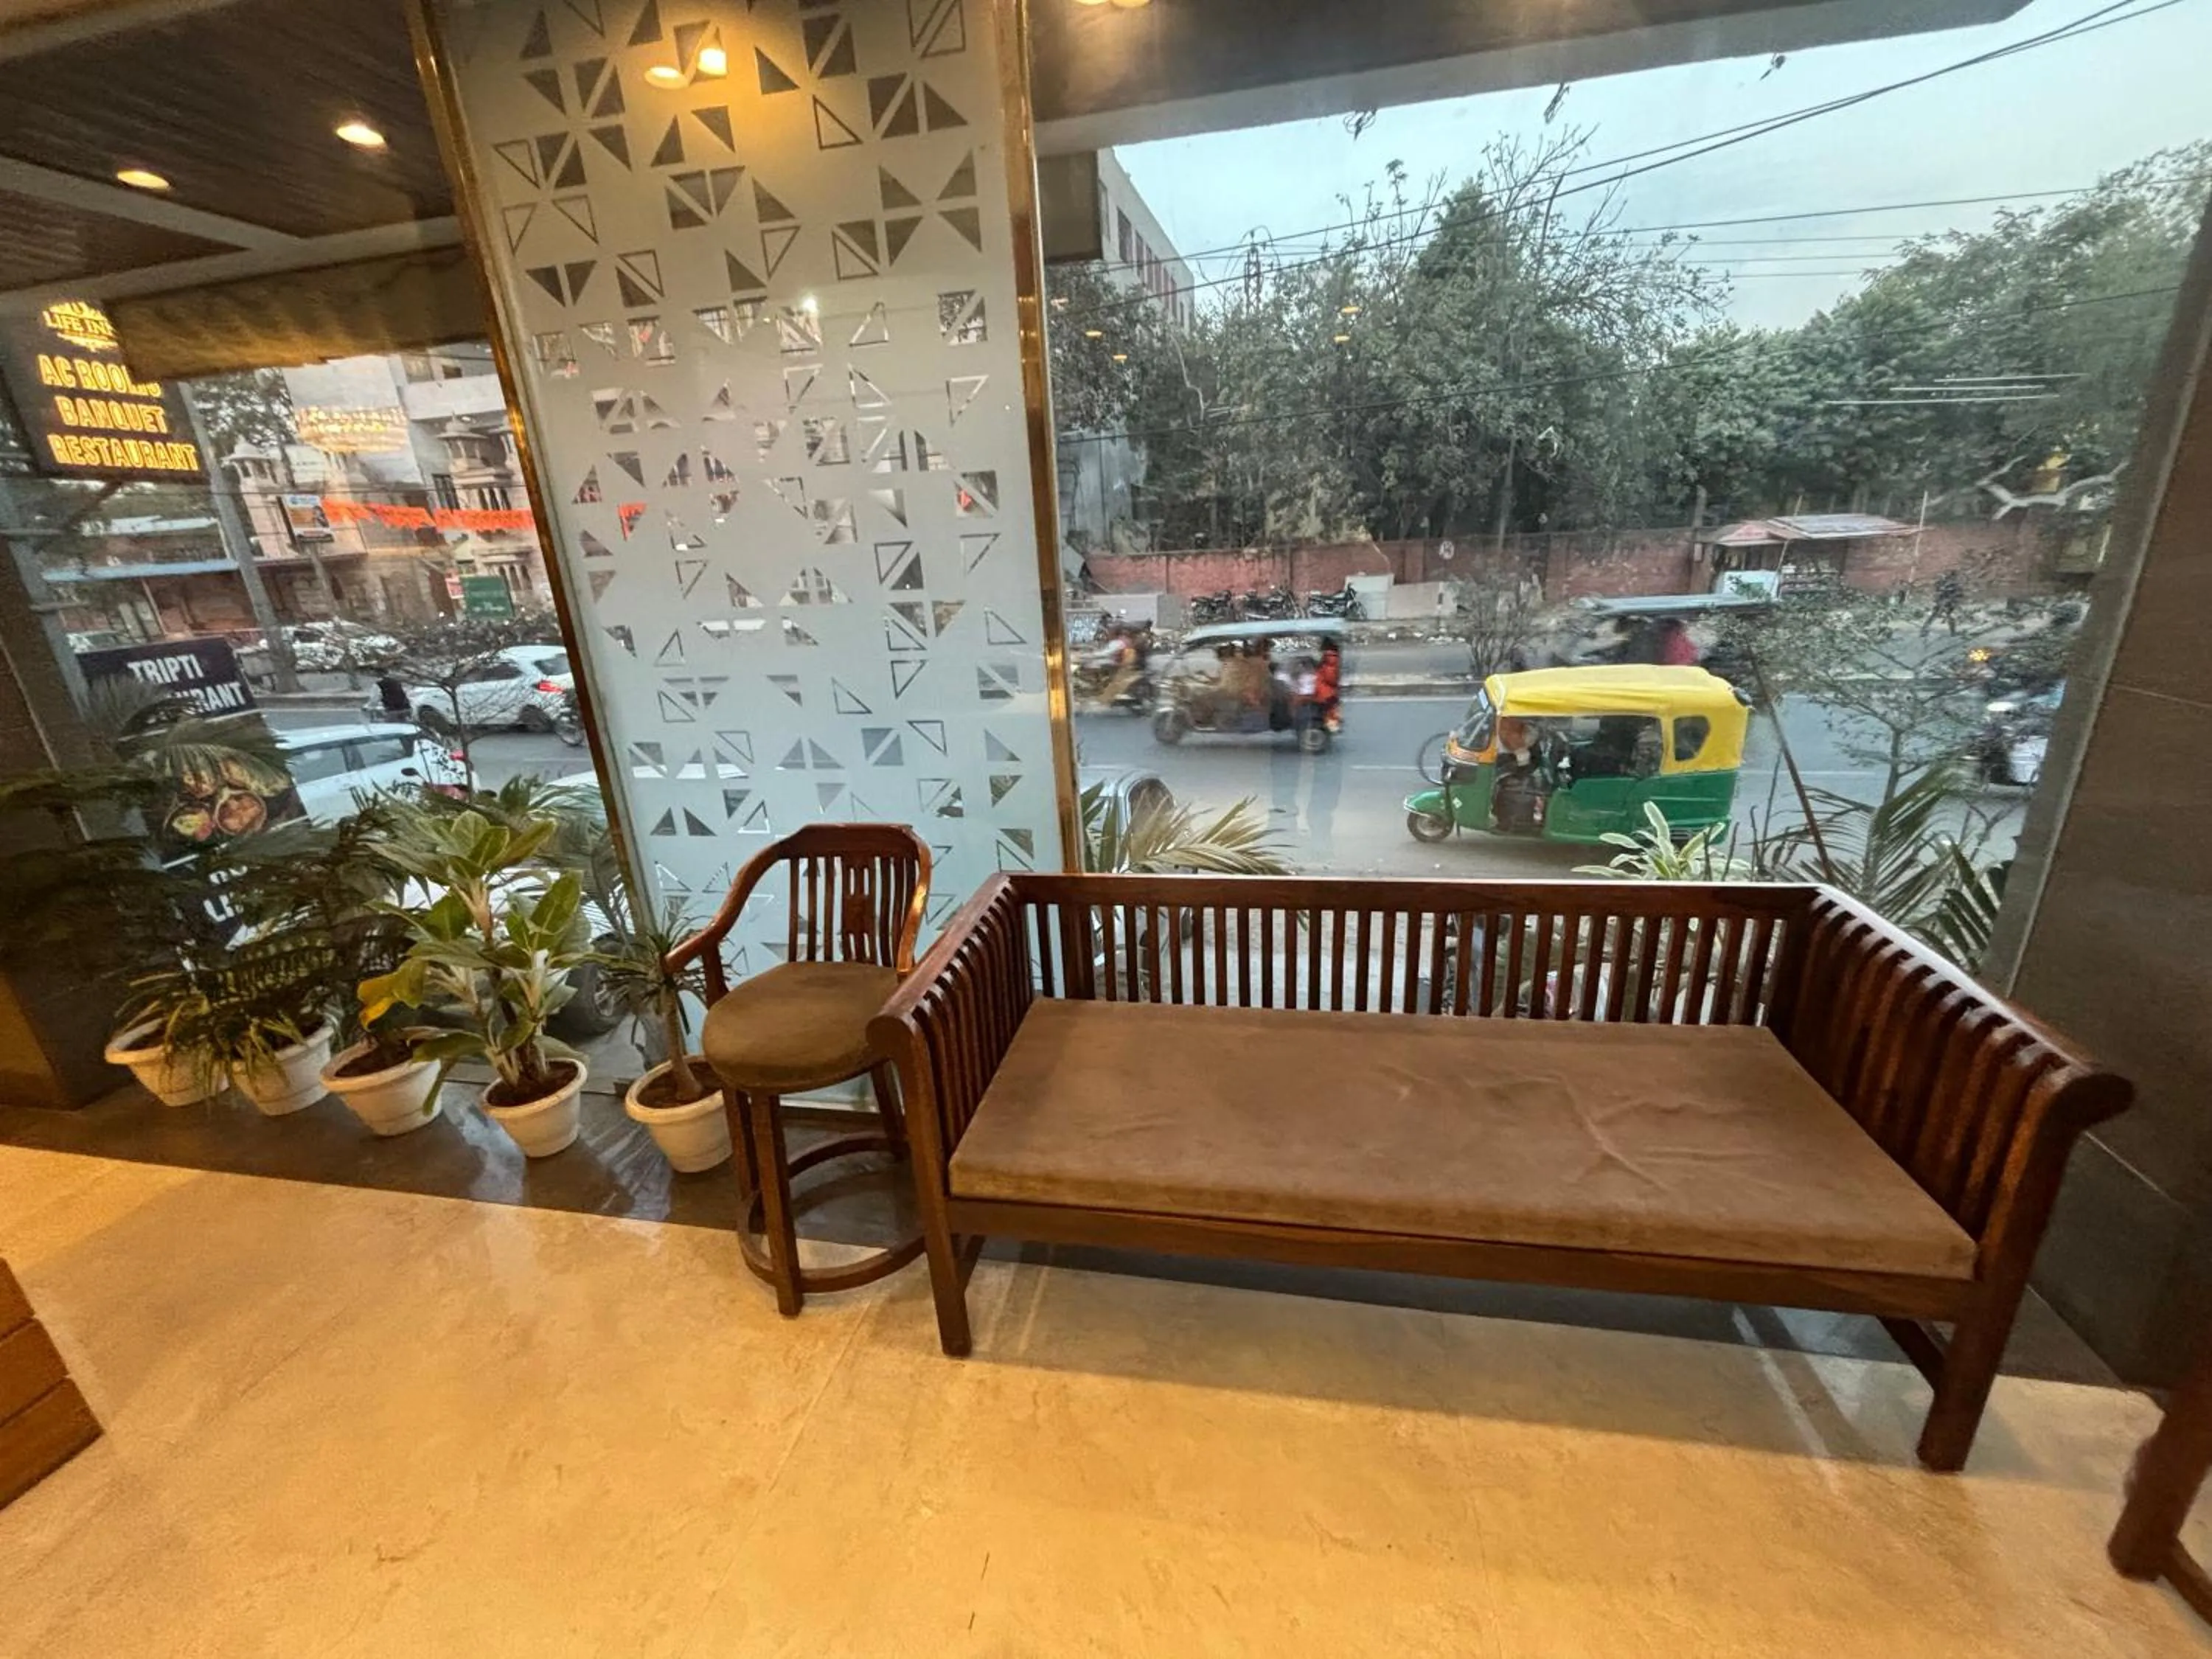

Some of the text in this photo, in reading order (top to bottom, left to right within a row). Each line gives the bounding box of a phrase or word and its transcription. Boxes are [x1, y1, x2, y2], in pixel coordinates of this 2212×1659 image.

[42, 310, 84, 331] LIFE
[84, 318, 116, 337] IN
[38, 354, 76, 388] AC
[55, 396, 168, 434] BANQUET
[47, 434, 199, 470] RESTAURANT
[127, 653, 204, 684] TRIPTI
